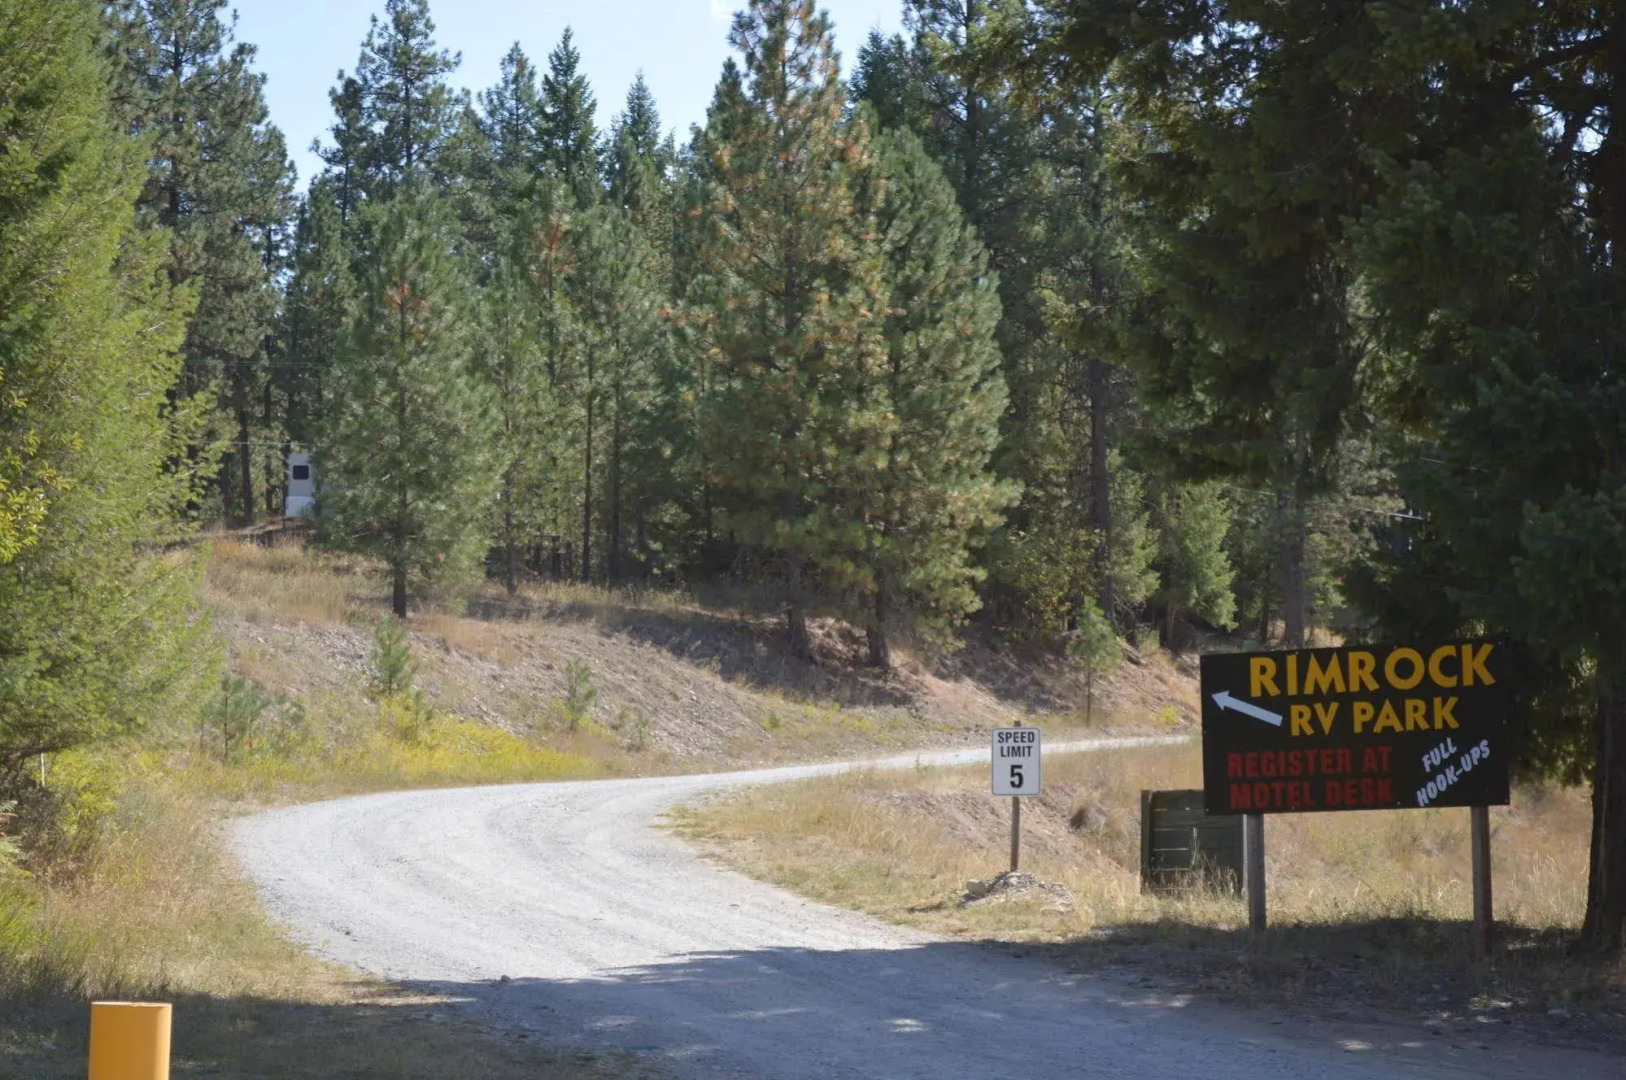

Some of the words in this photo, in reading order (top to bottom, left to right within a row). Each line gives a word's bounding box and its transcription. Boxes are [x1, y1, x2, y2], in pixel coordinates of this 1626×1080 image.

[1250, 643, 1497, 698] RIMROCK
[1290, 702, 1339, 736] RV
[1353, 696, 1460, 734] PARK
[998, 731, 1035, 743] SPEED
[1000, 746, 1033, 757] LIMIT
[1227, 748, 1353, 778] REGISTER
[1361, 746, 1393, 773] AT
[1421, 737, 1457, 773] FULL
[1010, 765, 1023, 789] 5
[1416, 739, 1490, 807] HOOK-UPS
[1230, 781, 1316, 810] MOTEL
[1325, 778, 1393, 806] DESK
